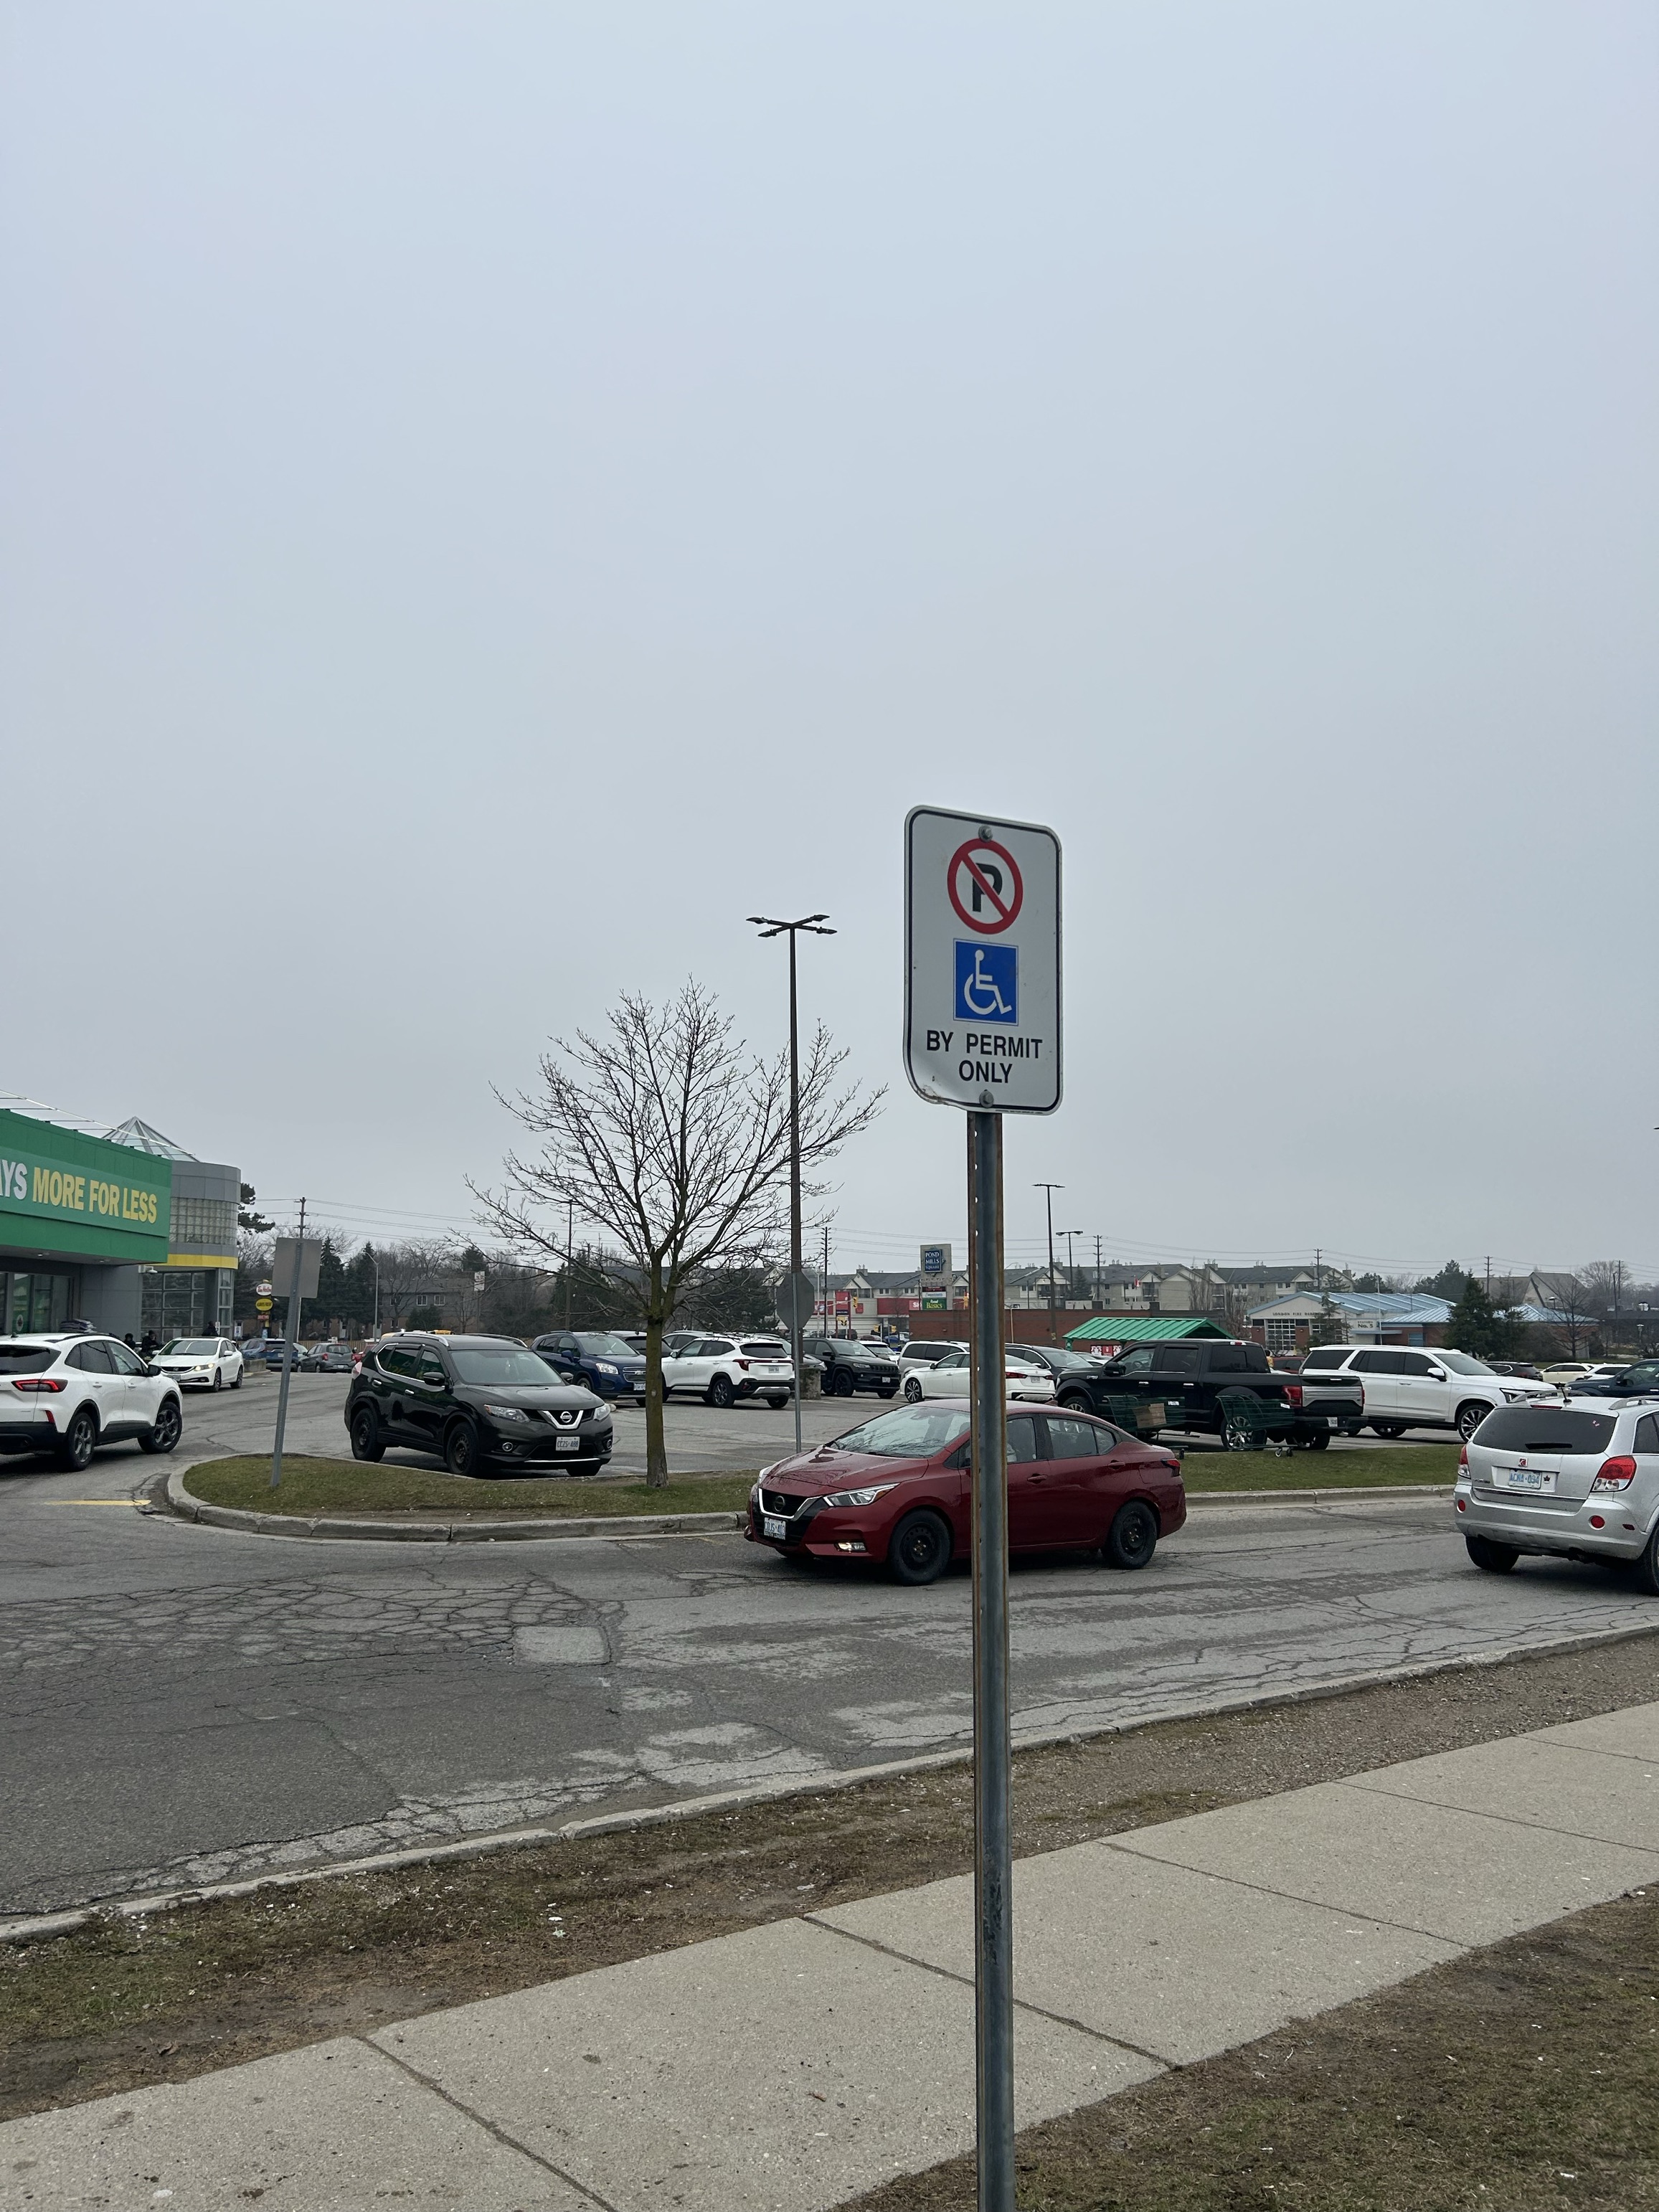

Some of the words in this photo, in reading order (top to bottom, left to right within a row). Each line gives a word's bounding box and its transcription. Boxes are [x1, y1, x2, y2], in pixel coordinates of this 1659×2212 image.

[927, 1030, 953, 1052] BY
[966, 1034, 1043, 1059] PERMIT
[959, 1059, 1013, 1084] ONLY
[0, 1159, 27, 1200] YS
[33, 1166, 85, 1211] MORE
[89, 1179, 120, 1217] FOR
[123, 1187, 158, 1224] LESS
